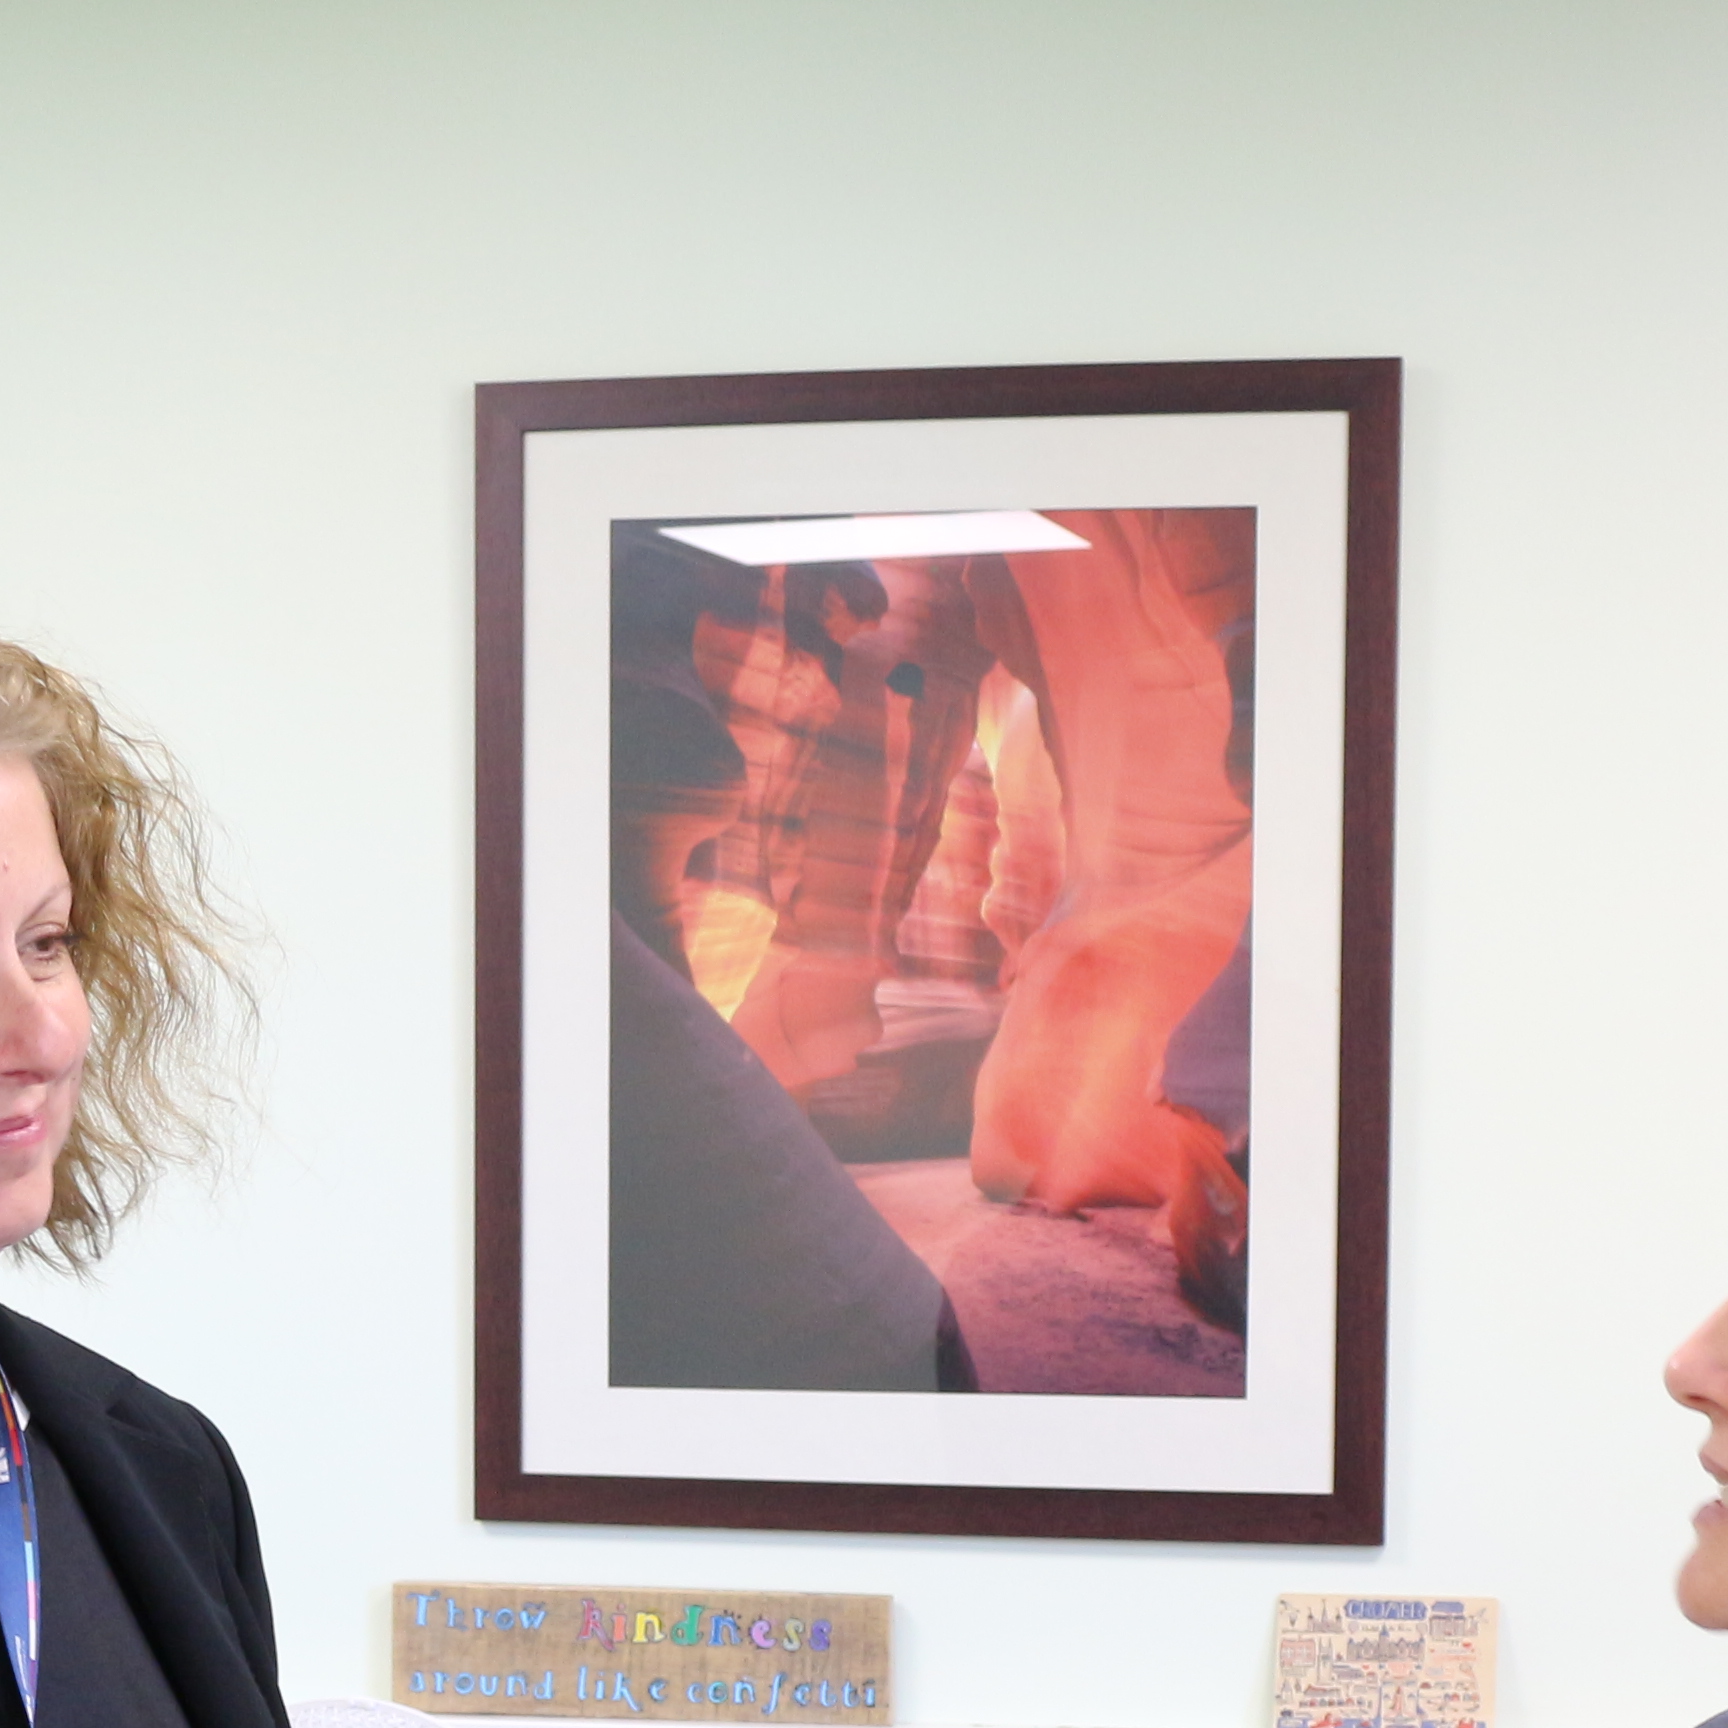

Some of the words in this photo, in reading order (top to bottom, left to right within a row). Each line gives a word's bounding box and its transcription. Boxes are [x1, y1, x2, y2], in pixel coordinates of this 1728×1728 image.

[407, 1590, 547, 1632] Throw
[578, 1598, 833, 1652] kindness
[409, 1668, 555, 1701] around
[578, 1665, 668, 1712] like
[688, 1671, 877, 1715] confetti
